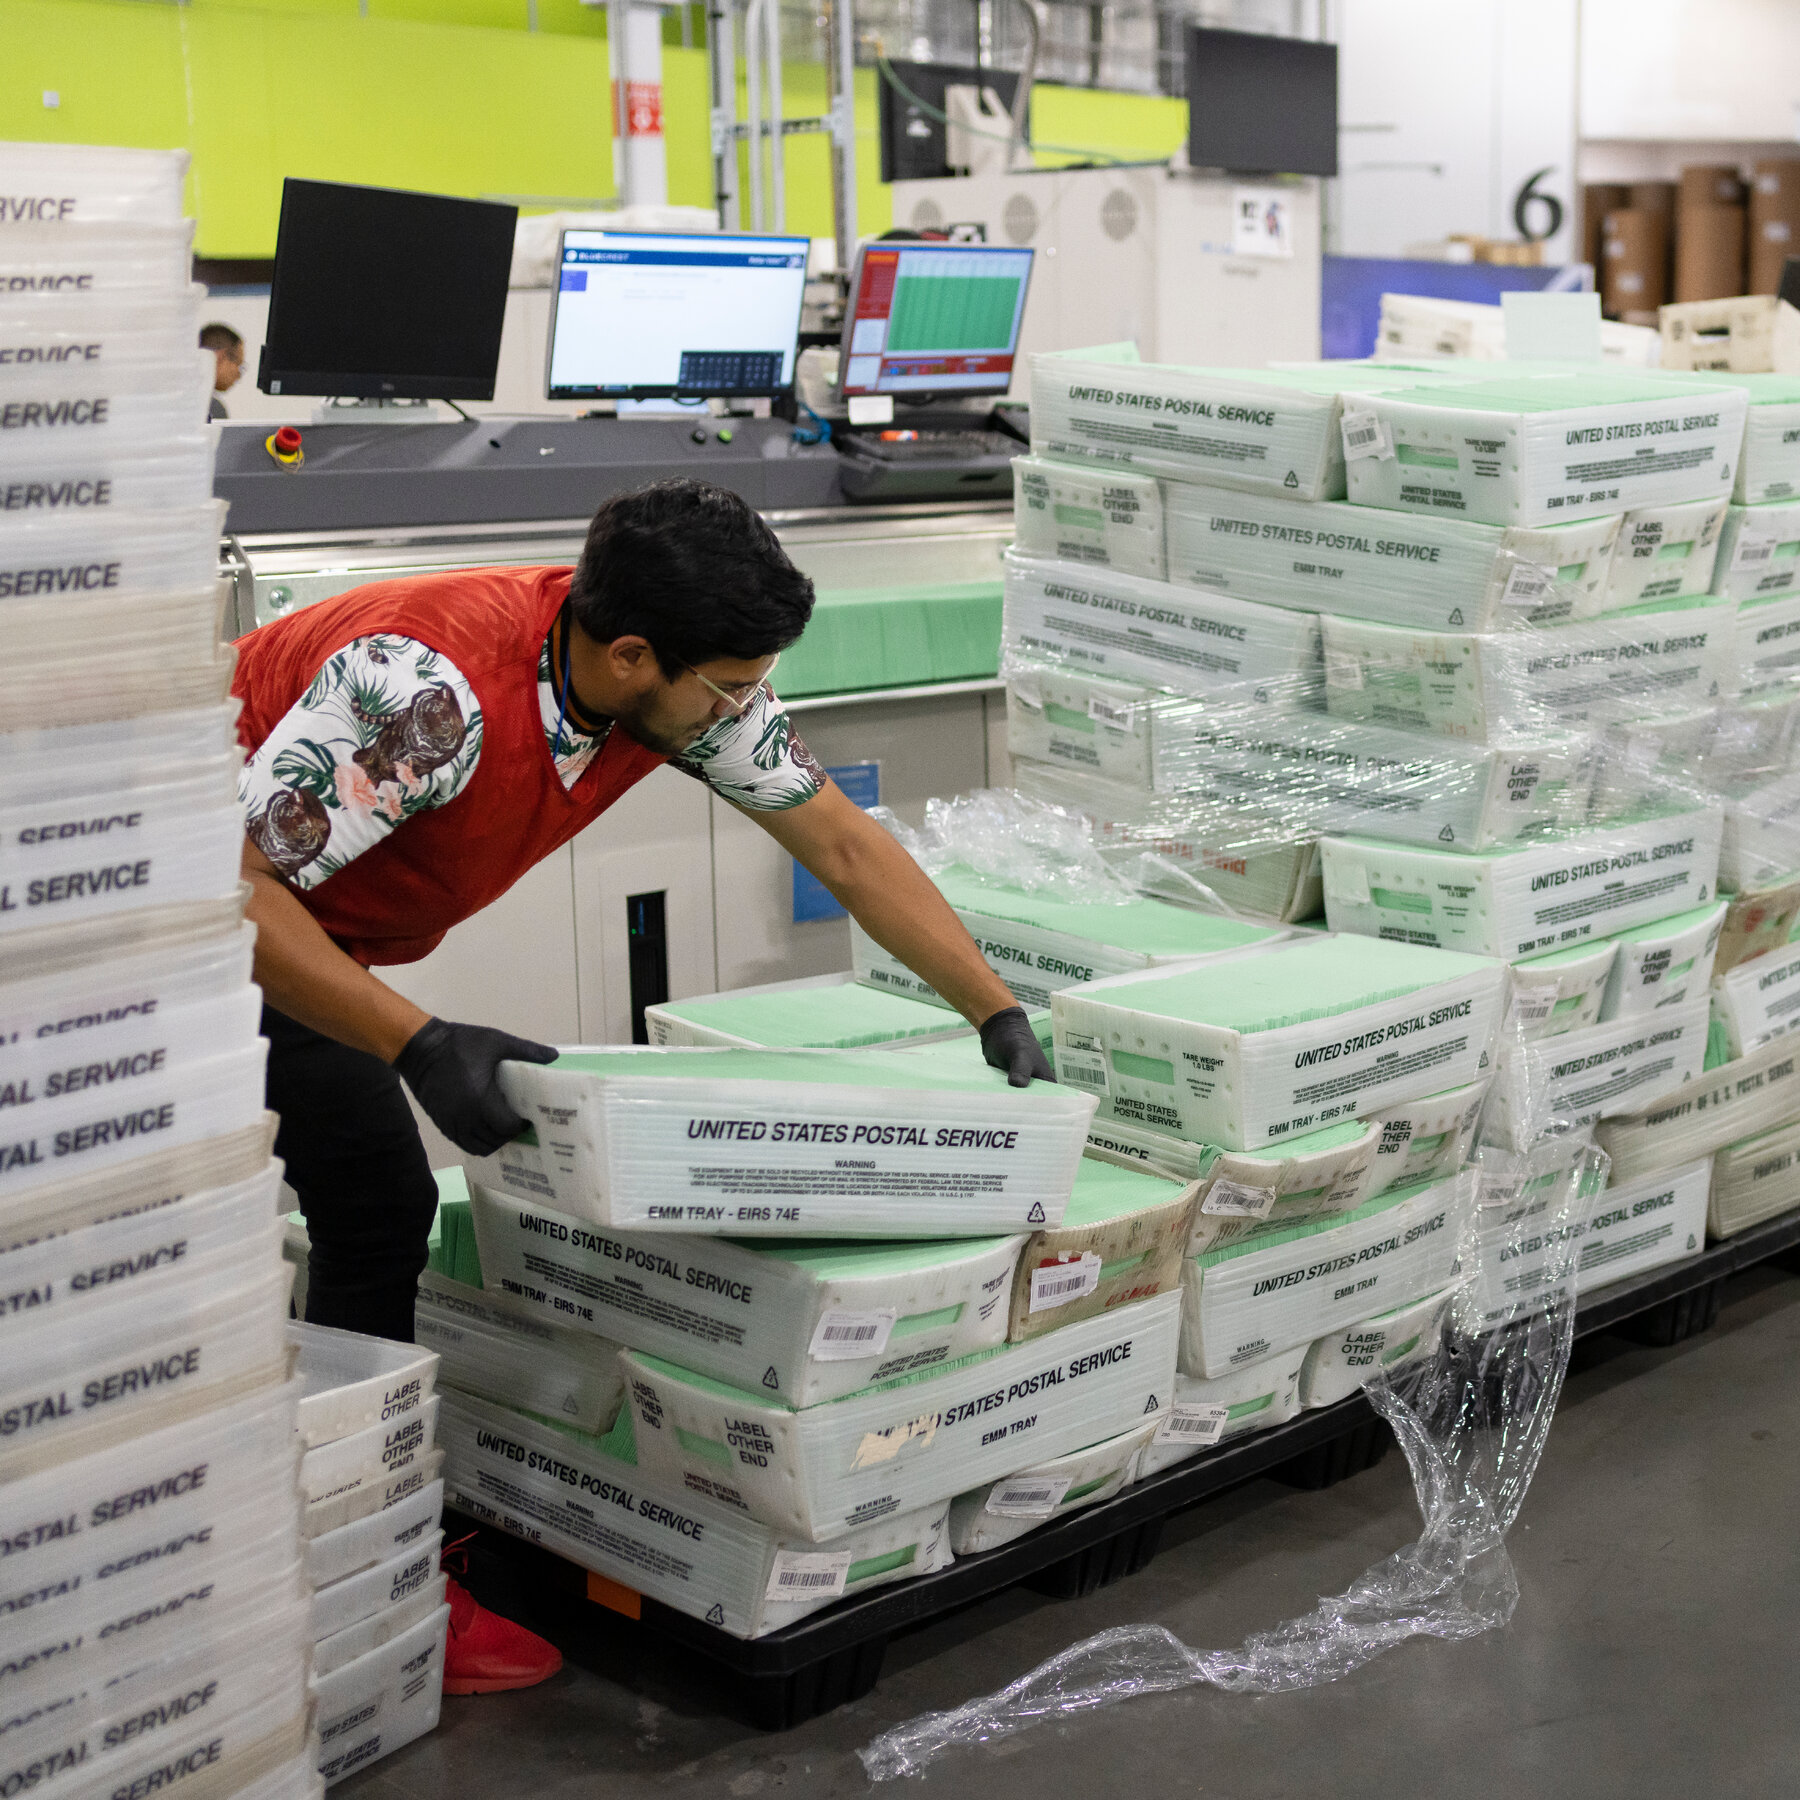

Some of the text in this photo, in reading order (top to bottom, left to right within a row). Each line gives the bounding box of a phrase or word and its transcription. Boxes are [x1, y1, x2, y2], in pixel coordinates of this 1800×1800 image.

[1514, 168, 1561, 242] 6
[1069, 385, 1275, 427] UNITED STATES POSTAL SERVICE
[1566, 412, 1721, 446] UNITED STATES POSTAL SERVICE
[1432, 498, 1466, 510] SERVICE
[1210, 516, 1441, 562] UNITED STATES POSTAL SERVICE
[1318, 565, 1344, 579] TRAY
[1043, 584, 1248, 642] UNITED STATES POSTAL SERVICE
[1531, 839, 1694, 892] UNITED STATES POSTAL SERVICE
[26, 860, 152, 906] SERVICE
[1379, 925, 1437, 941] UNITED STATES
[1518, 924, 1592, 953] EMM TRAY EIRS 74E
[984, 940, 1094, 982] POSTAL SERVICE
[870, 969, 912, 989] EMM TRAY
[1295, 999, 1473, 1069] UNITED STATES POSTAL SERVICE
[1182, 1052, 1225, 1067] TARE WEIGHT
[1376, 1051, 1399, 1064] WARNING
[1586, 1045, 1619, 1069] STATES
[45, 1048, 167, 1098] SERVICE
[1114, 1106, 1183, 1130] POSTAL SERVICE
[1115, 1096, 1178, 1118] UNITED STATES
[1268, 1101, 1357, 1137] EMM TRAY EIRS 74E
[53, 1102, 175, 1157] SERVICE
[687, 1119, 1019, 1149] UNITED STATES POSTAL SERVICE
[1377, 1143, 1400, 1155] END
[835, 1160, 876, 1170] WARNING
[647, 1206, 800, 1222] EMM TRAY EIRS 74E
[1590, 1190, 1675, 1232] POSTAL SERVICE
[519, 1211, 753, 1304] UNITED STATES POSTAL SERVICE
[1253, 1212, 1446, 1297] UNITED STATES POSTAL SERVICE
[613, 1274, 644, 1292] WARNING
[1334, 1275, 1379, 1300] EMM TRAY
[501, 1278, 594, 1322] EMM TRAY EIRS 74E
[1341, 1341, 1385, 1355] OTHER
[1346, 1331, 1386, 1343] LABEL
[870, 1353, 948, 1382] POSTAL SERVICE
[878, 1345, 950, 1371] UNITED STATES
[1347, 1355, 1374, 1367] END
[81, 1348, 201, 1409] SERVICE
[384, 1379, 422, 1405] LABEL
[631, 1377, 660, 1403] LABEL
[944, 1389, 1004, 1427] STATES
[1007, 1368, 1066, 1403] POSTAL
[1068, 1341, 1133, 1380] SERVICE
[381, 1393, 420, 1421] OTHER
[633, 1391, 665, 1418] OTHER
[385, 1418, 424, 1448] LABEL
[641, 1409, 661, 1430] END
[724, 1416, 771, 1439] LABEL
[981, 1414, 1038, 1446] EMM TRAY
[382, 1432, 423, 1463] OTHER
[727, 1433, 775, 1454] OTHER
[739, 1450, 768, 1468] END
[90, 1463, 209, 1528] SERVICE
[386, 1472, 424, 1500] LABEL
[476, 1430, 705, 1542] UNITED STATES POSTAL SERVICE
[684, 1480, 717, 1499] POSTAL
[565, 1499, 595, 1520] WARNING
[855, 1494, 893, 1513] WARNING
[474, 1500, 542, 1544] TRAY EIRS 74E
[390, 1568, 430, 1601] OTHER
[393, 1556, 430, 1586] LABEL
